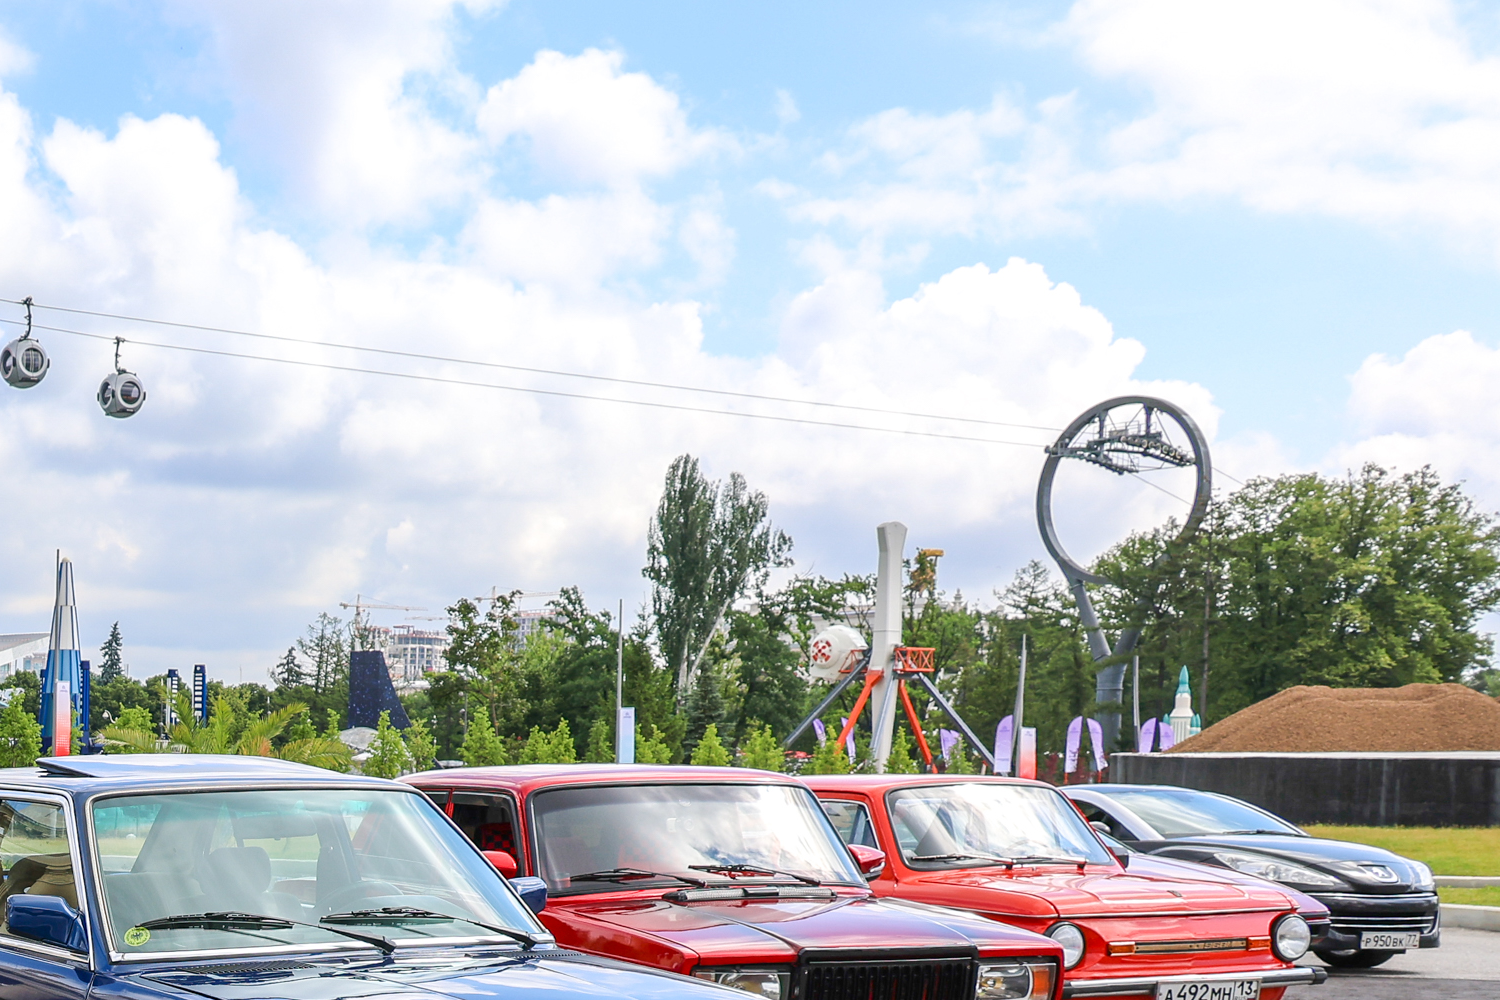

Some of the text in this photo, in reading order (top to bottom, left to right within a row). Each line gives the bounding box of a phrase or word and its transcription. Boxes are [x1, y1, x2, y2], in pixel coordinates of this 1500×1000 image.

[1365, 934, 1417, 947] Р950ВК 77
[1237, 981, 1253, 996] 13
